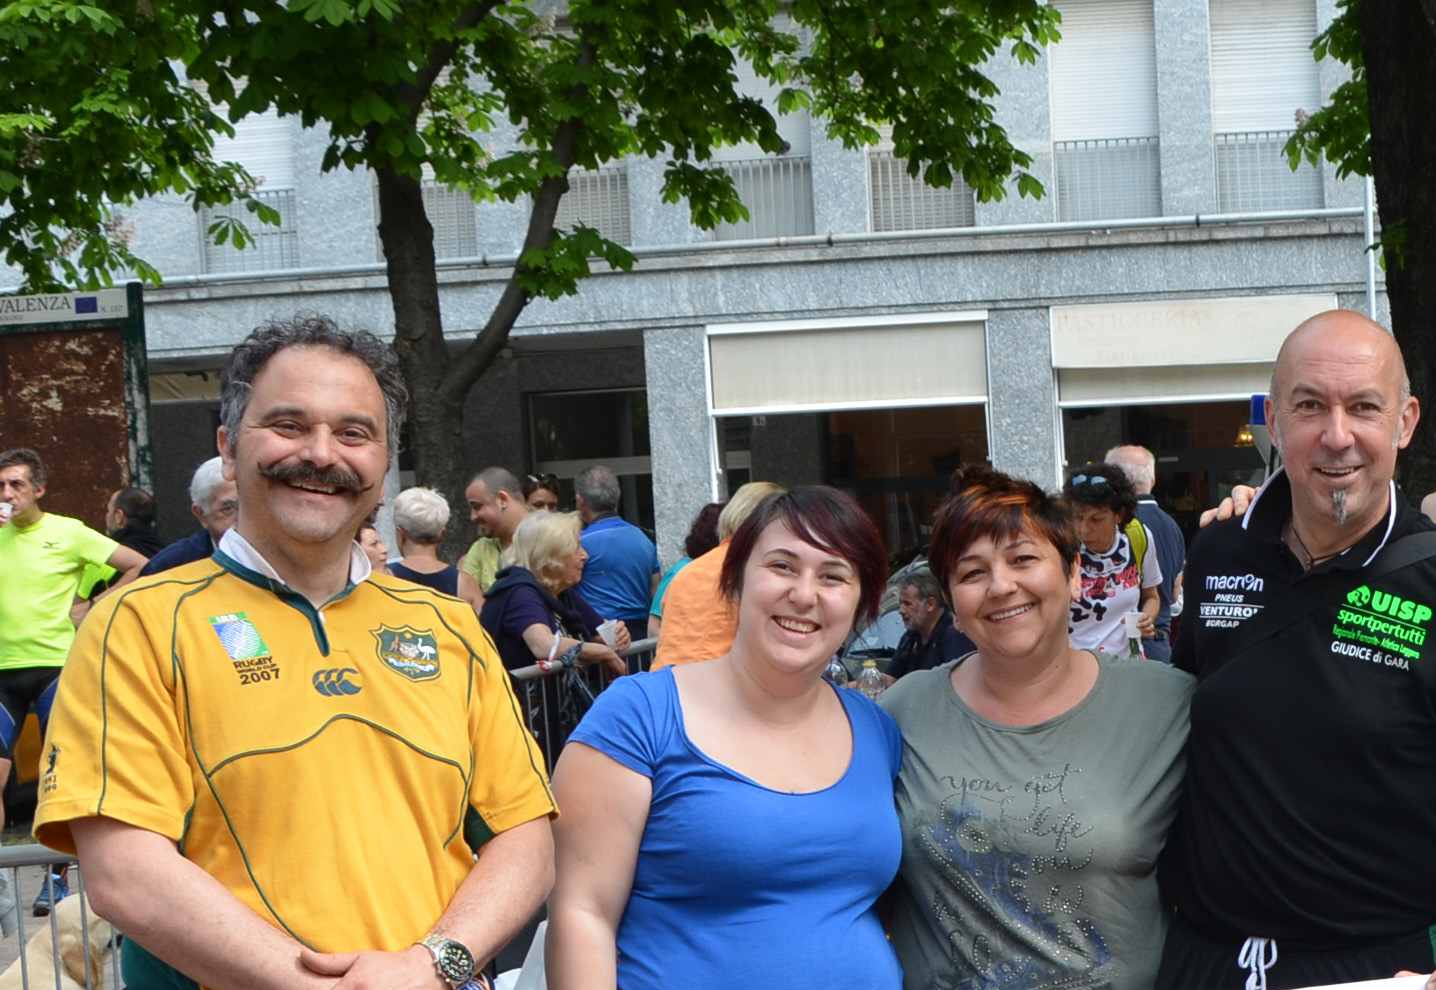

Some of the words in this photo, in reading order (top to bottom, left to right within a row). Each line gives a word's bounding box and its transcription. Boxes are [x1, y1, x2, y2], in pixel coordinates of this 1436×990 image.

[1056, 309, 1203, 332] PASTICCERIA
[1205, 573, 1264, 592] macron
[1214, 593, 1245, 603] PNEUS
[1371, 590, 1433, 624] UISP
[1337, 609, 1427, 646] sportpertutti
[232, 655, 273, 670] RUGBY
[1331, 640, 1373, 661] GIUDICE
[1372, 651, 1383, 664] di
[1384, 654, 1410, 671] GARA
[236, 665, 260, 674] WORLD
[260, 663, 278, 671] CUP
[239, 667, 281, 685] 2007
